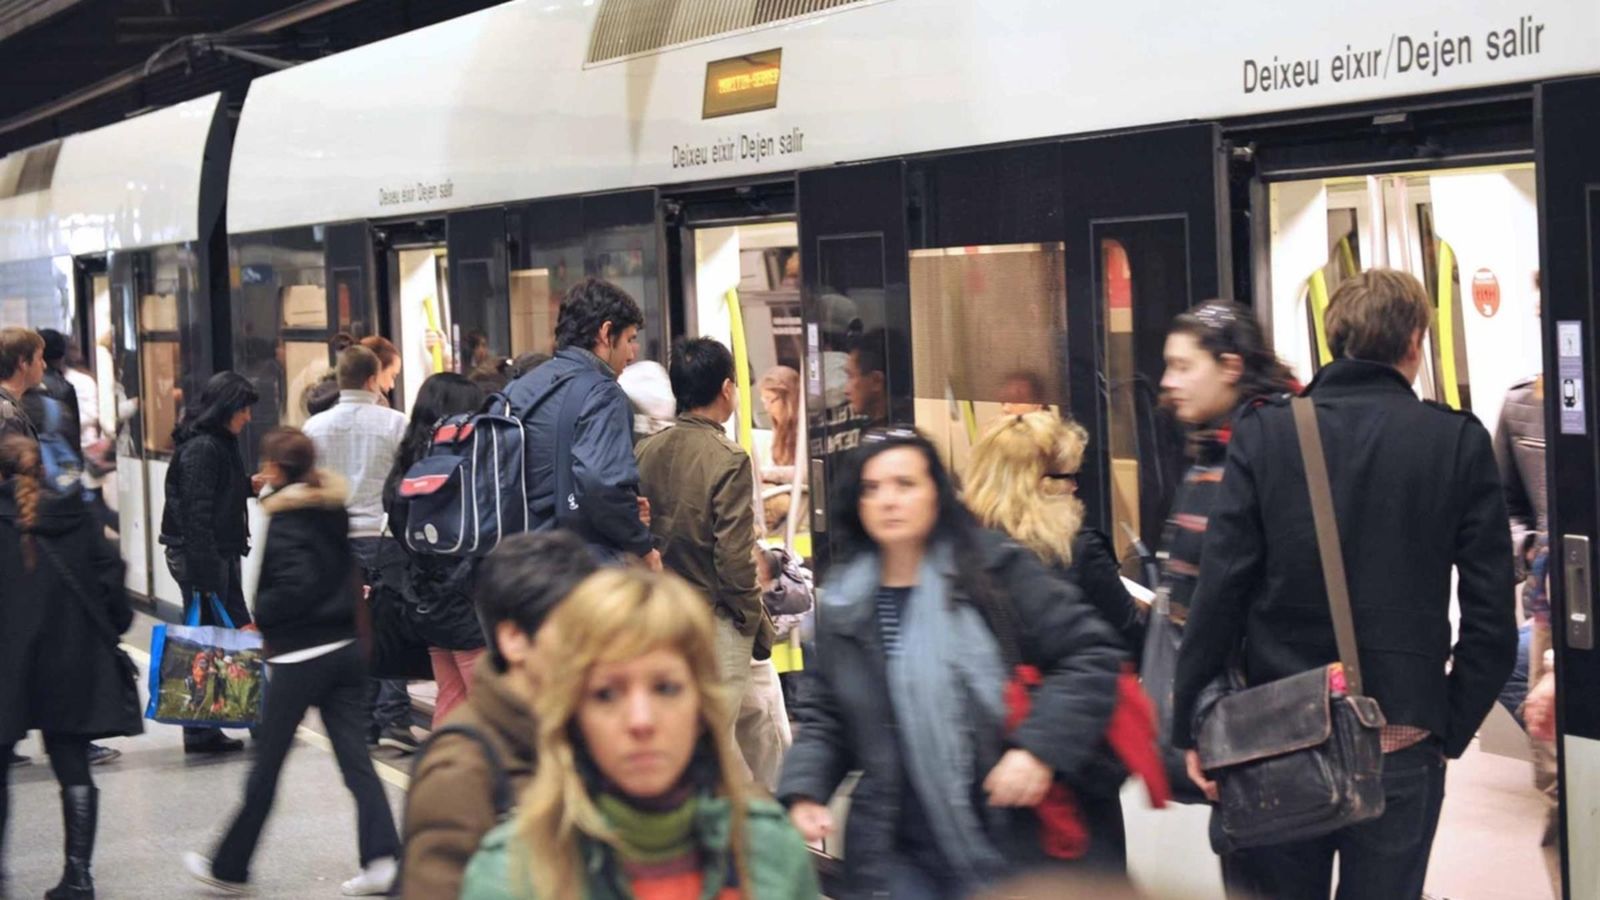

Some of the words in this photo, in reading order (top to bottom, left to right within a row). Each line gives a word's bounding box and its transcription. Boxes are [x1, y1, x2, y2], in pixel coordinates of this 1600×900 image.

[1243, 56, 1319, 94] Deixeu
[1486, 15, 1545, 61] salir
[672, 143, 708, 169] Deixeu
[779, 127, 804, 155] salir
